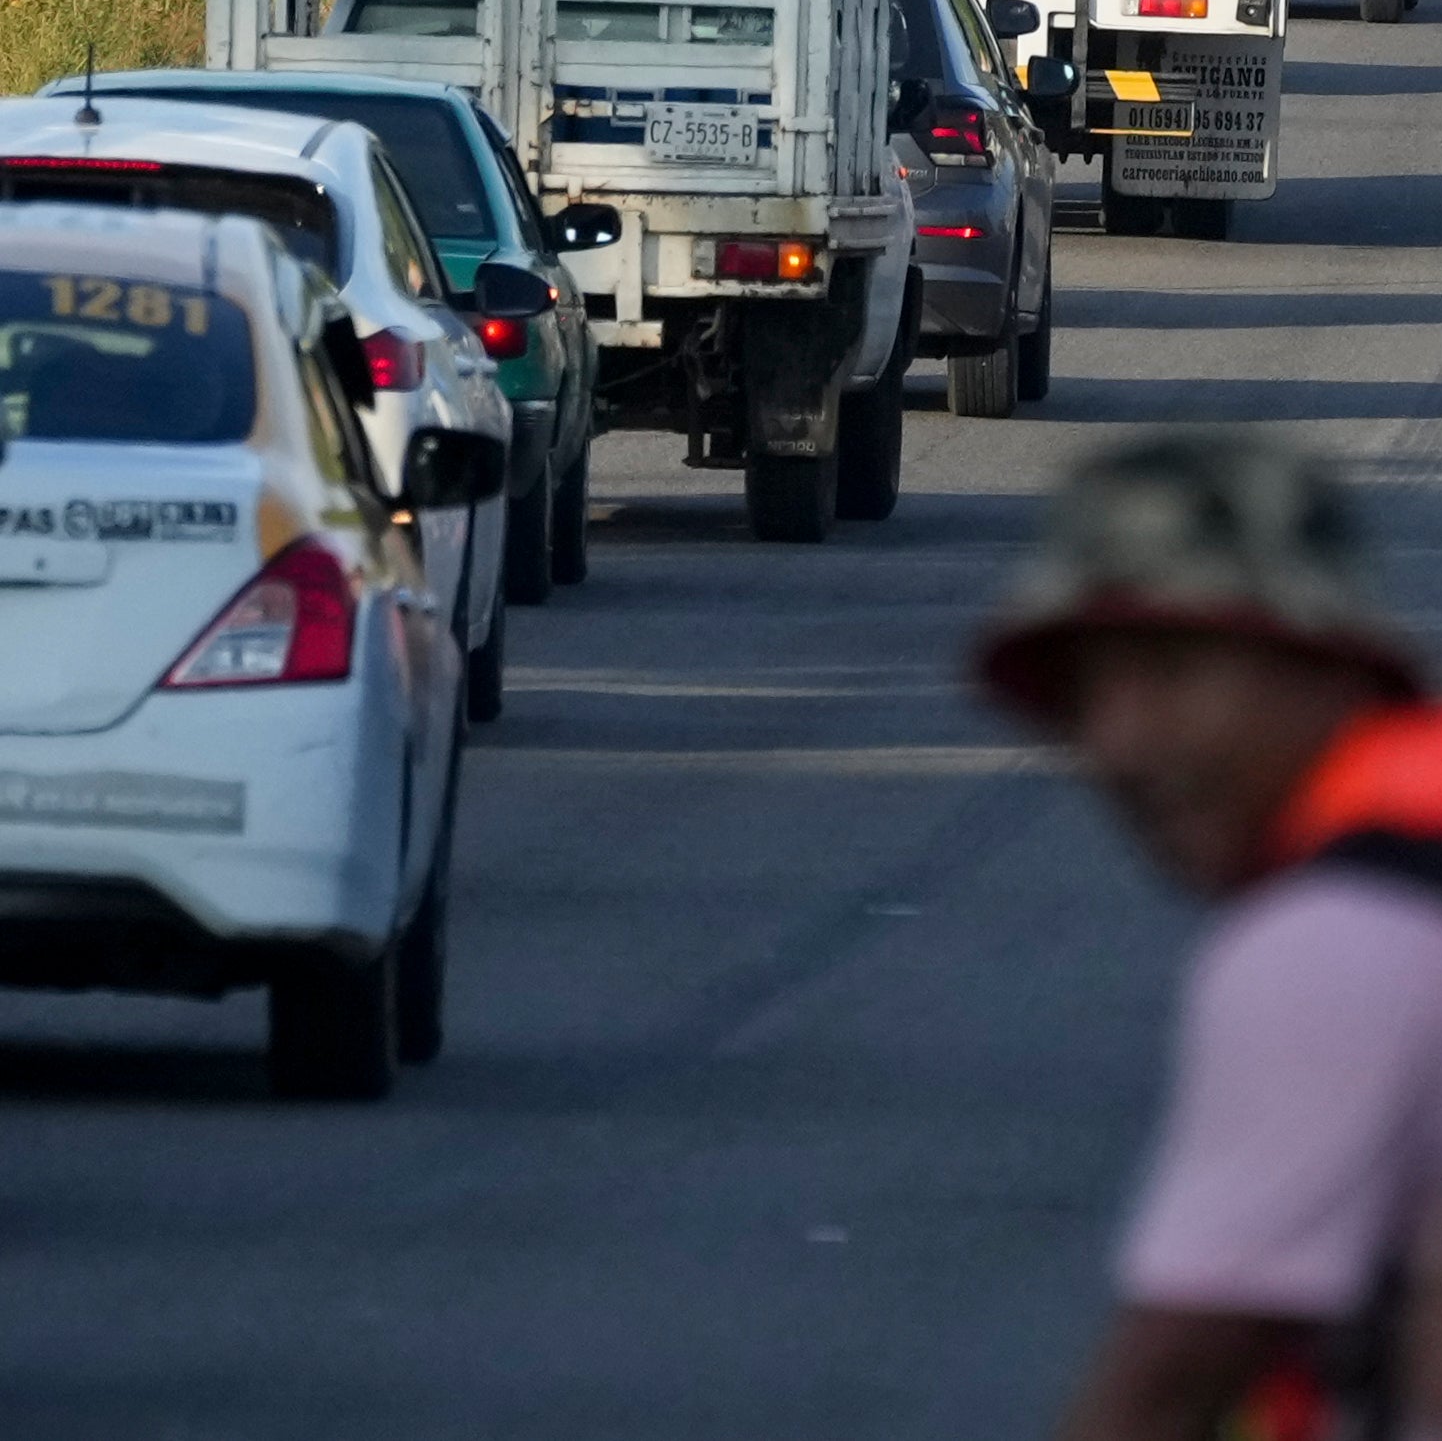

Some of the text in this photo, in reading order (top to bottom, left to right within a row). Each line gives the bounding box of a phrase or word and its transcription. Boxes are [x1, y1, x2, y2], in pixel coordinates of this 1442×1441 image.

[650, 119, 753, 148] CZ-5535-B
[1129, 107, 1144, 129] 01
[1148, 107, 1188, 130] (594)
[1214, 110, 1242, 132] 694
[1246, 111, 1264, 132] 37
[42, 275, 211, 338] 1281
